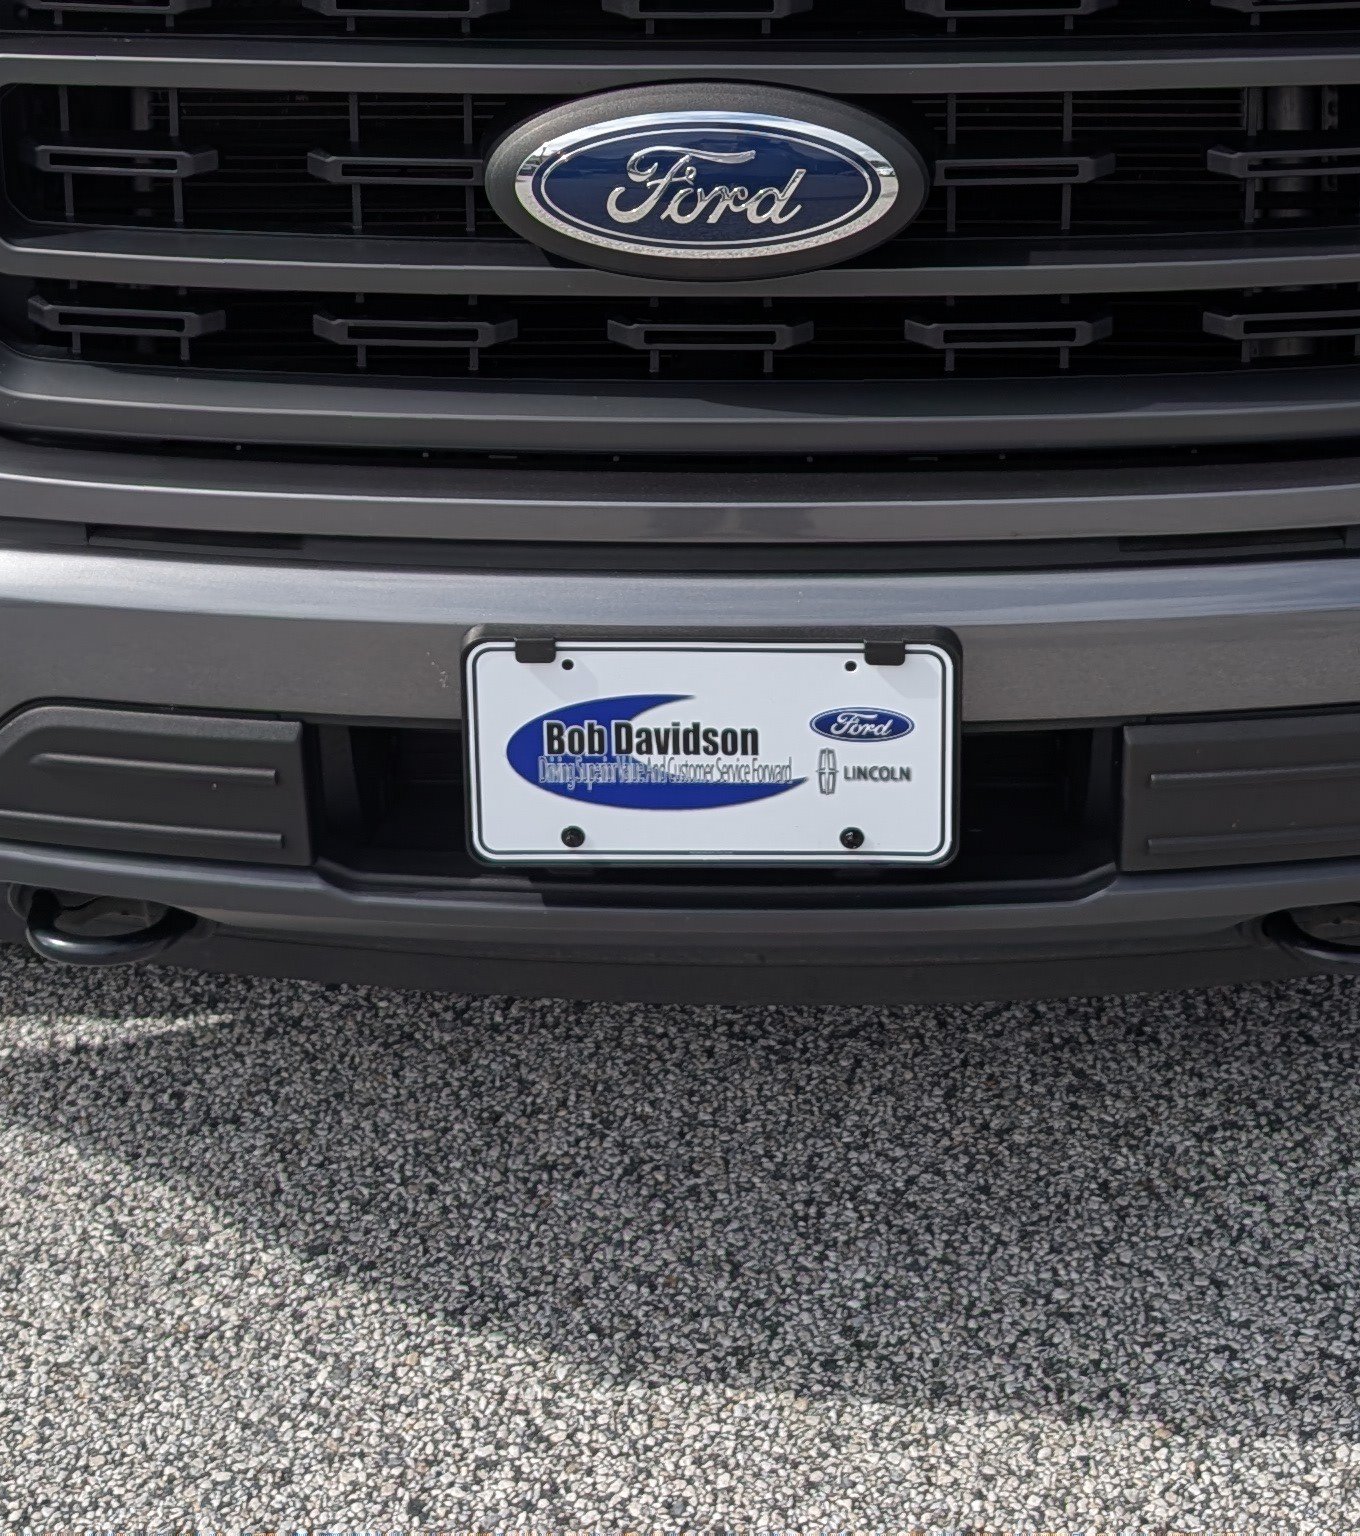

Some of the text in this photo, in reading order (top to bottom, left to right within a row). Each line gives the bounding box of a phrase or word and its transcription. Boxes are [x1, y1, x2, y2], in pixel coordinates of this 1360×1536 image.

[606, 146, 807, 225] Ford
[830, 712, 894, 736] Ford
[545, 720, 760, 756] Bob Davidson
[667, 756, 715, 783] Customer
[715, 756, 751, 783] Service
[751, 756, 792, 783] Forward
[843, 765, 912, 782] LINCOLN
